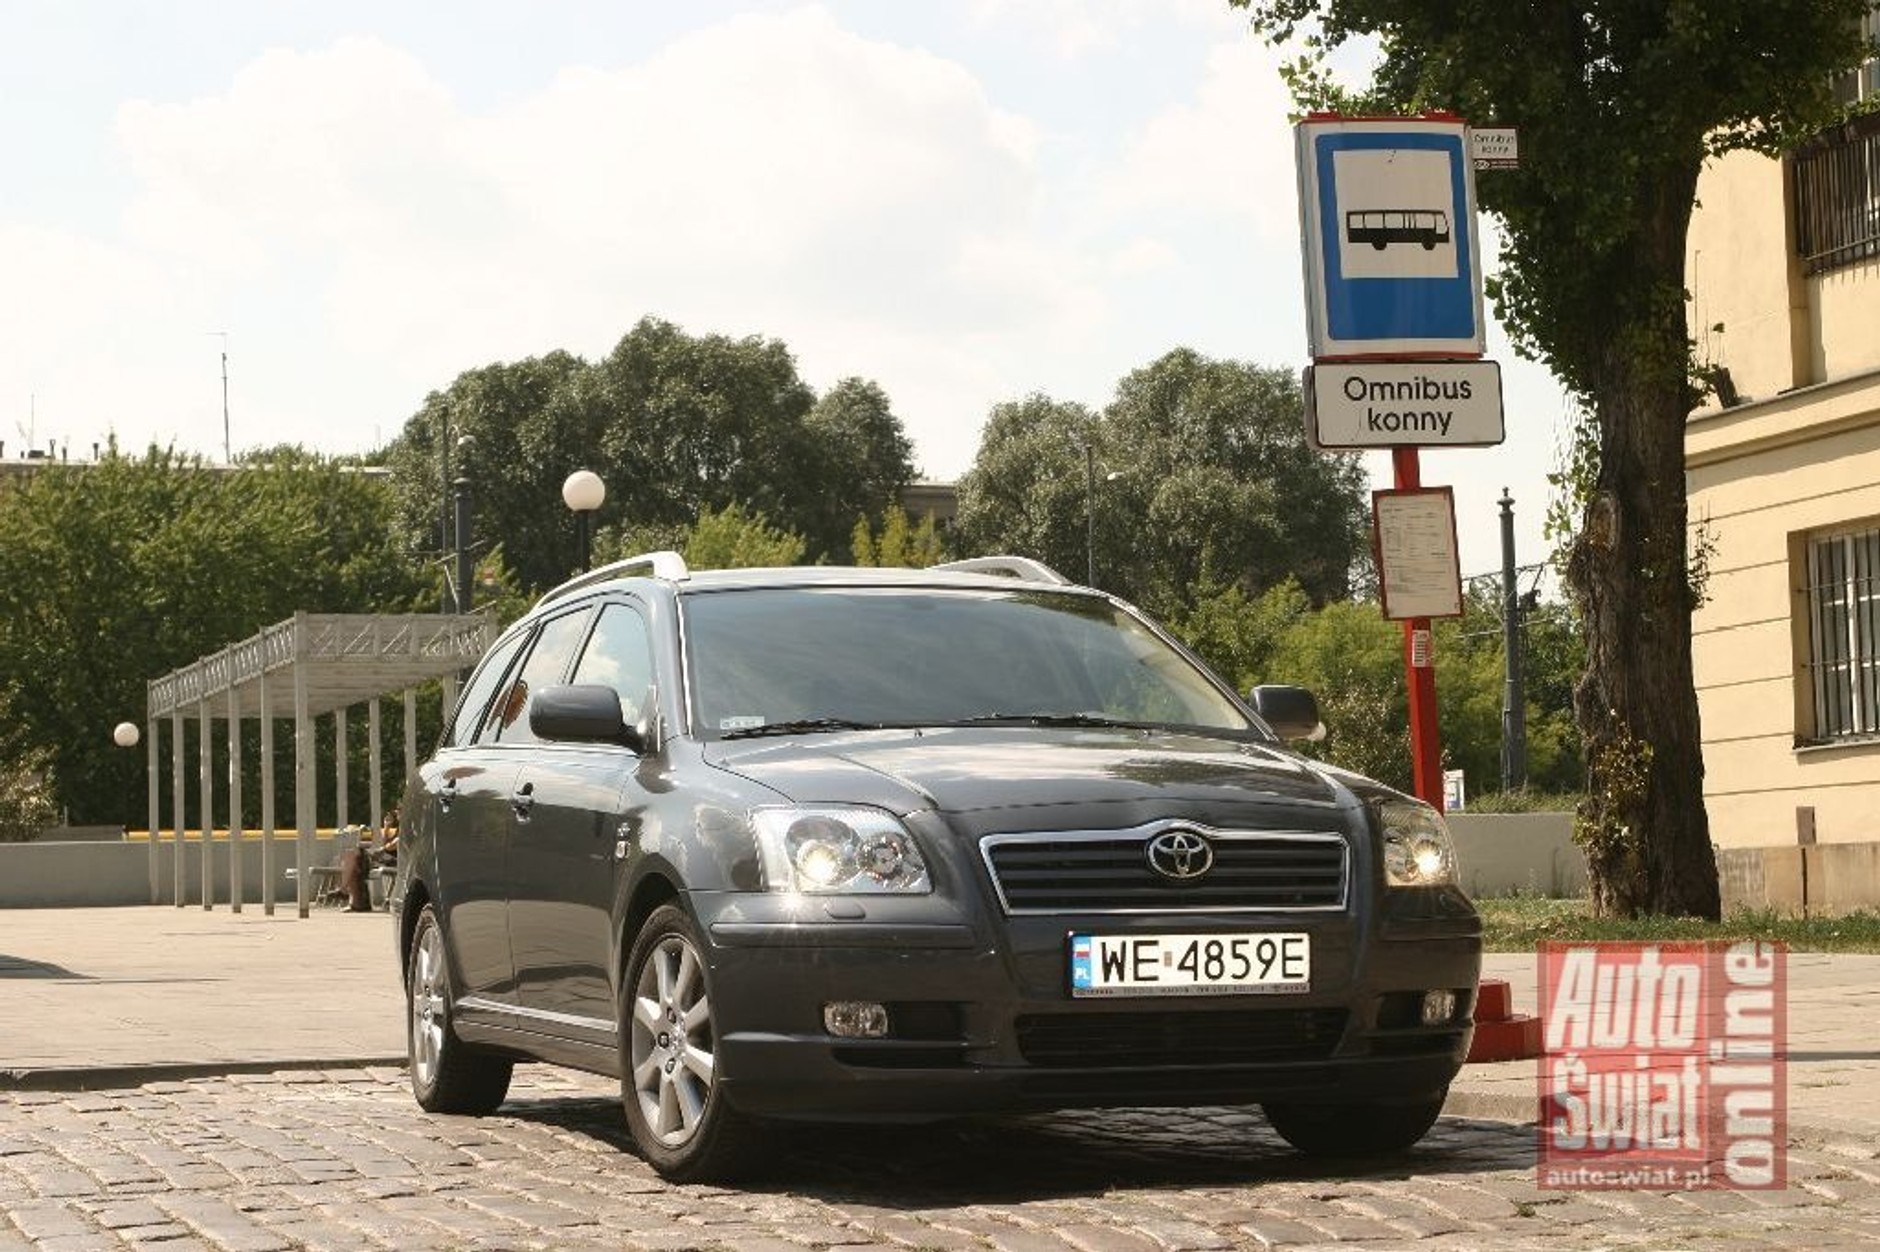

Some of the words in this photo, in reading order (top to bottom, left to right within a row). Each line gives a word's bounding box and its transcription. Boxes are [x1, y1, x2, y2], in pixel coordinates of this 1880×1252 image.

[1344, 376, 1472, 401] Omnibus
[1368, 407, 1453, 436] konny
[1100, 940, 1159, 982] WE
[1177, 938, 1304, 981] 4859E
